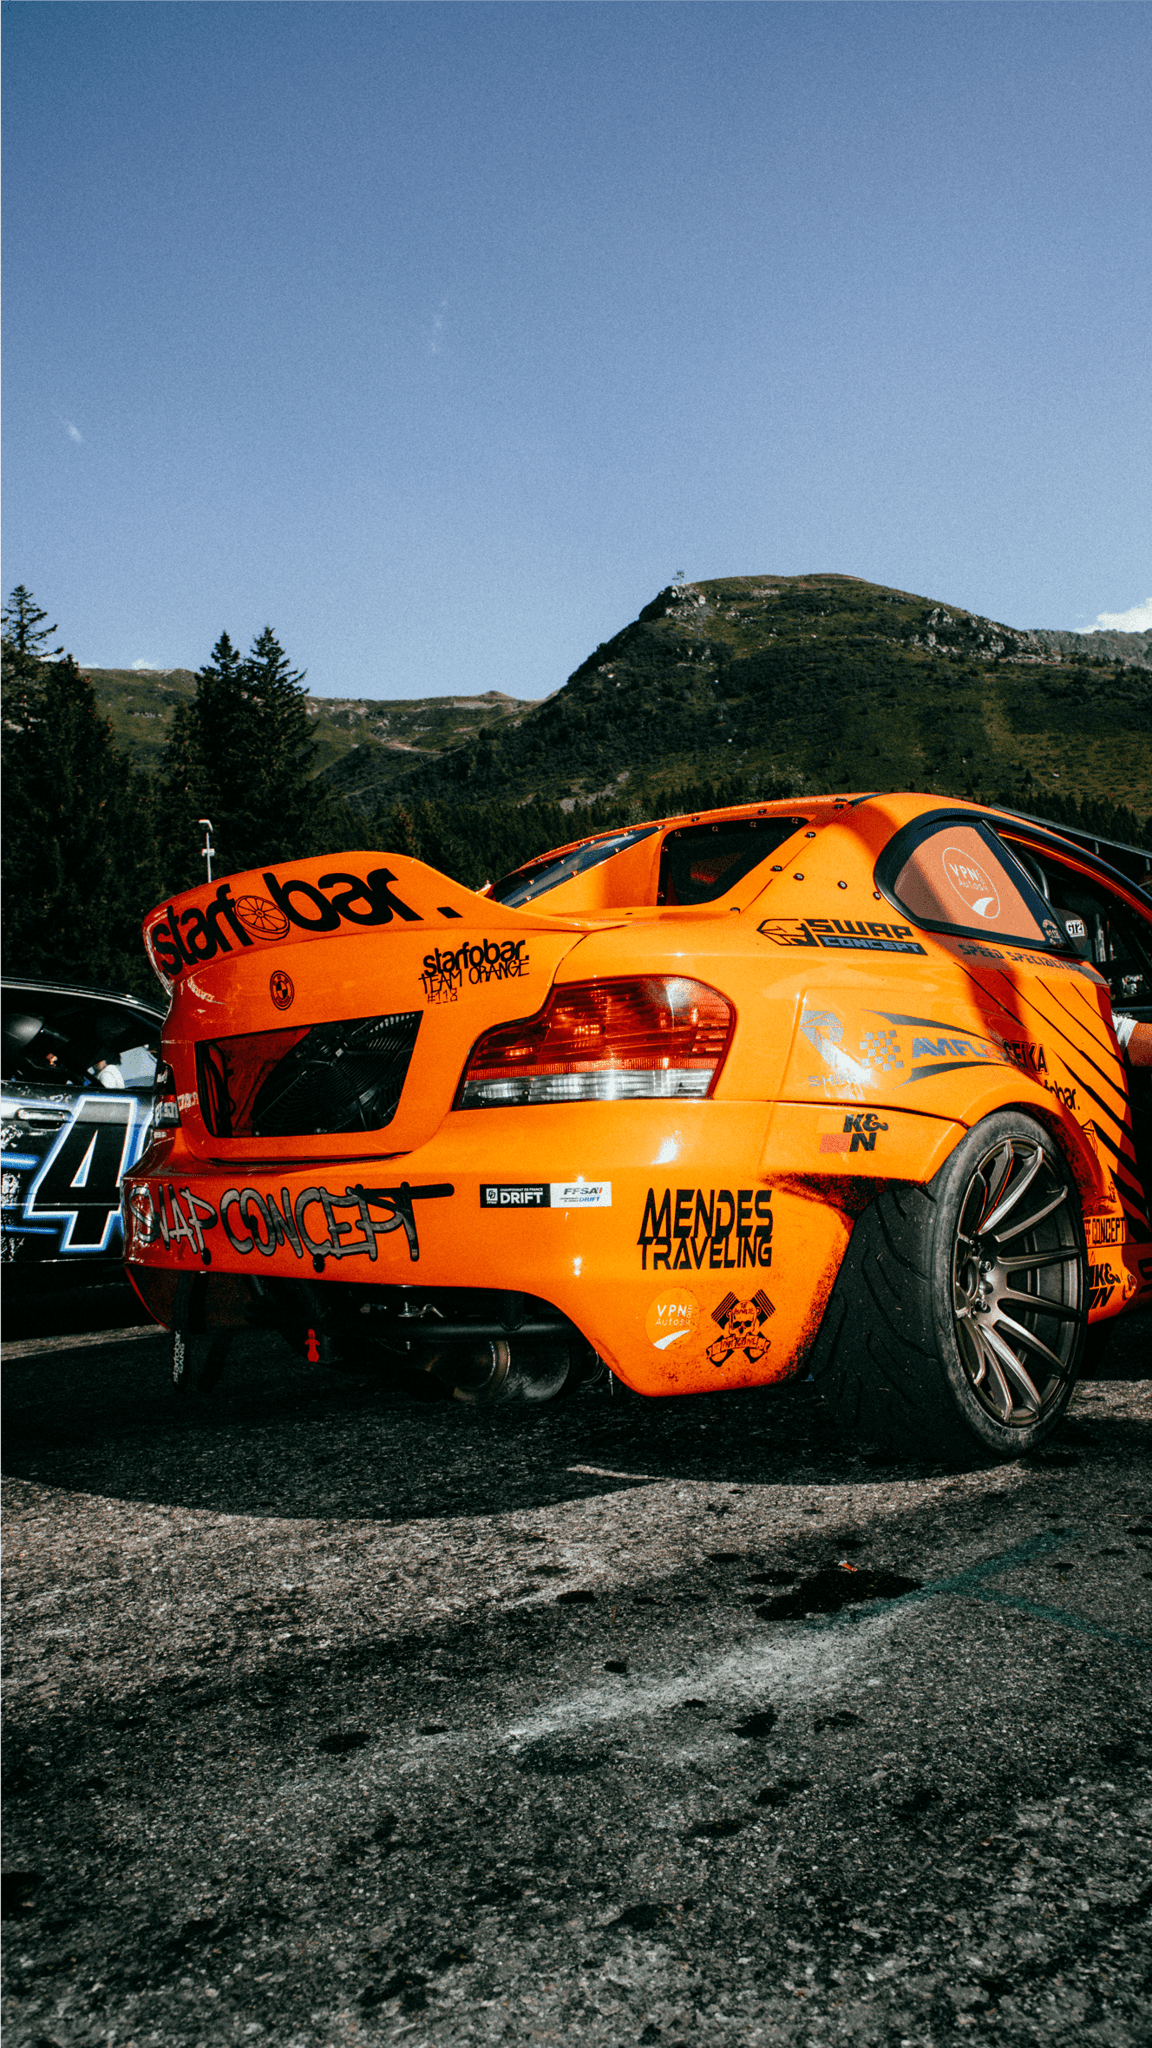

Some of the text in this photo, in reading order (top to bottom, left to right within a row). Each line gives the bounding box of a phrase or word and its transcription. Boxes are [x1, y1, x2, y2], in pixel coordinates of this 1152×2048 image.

[948, 862, 979, 881] VPN
[803, 918, 914, 939] SWAP
[820, 935, 920, 953] CONCEPT
[958, 943, 1004, 960] SPEED
[423, 938, 530, 977] starfobar.
[418, 960, 530, 994] TEAM ORANGE
[843, 1112, 889, 1133] K&
[849, 1132, 877, 1152] N
[500, 1191, 544, 1204] DRIFT
[564, 1187, 599, 1195] FFSA
[220, 1182, 455, 1262] CONCEPT
[638, 1188, 774, 1238] MENDES
[1092, 1217, 1125, 1244] CONCEPT
[637, 1236, 773, 1270] TRAVELING
[657, 1304, 687, 1317] VPN
